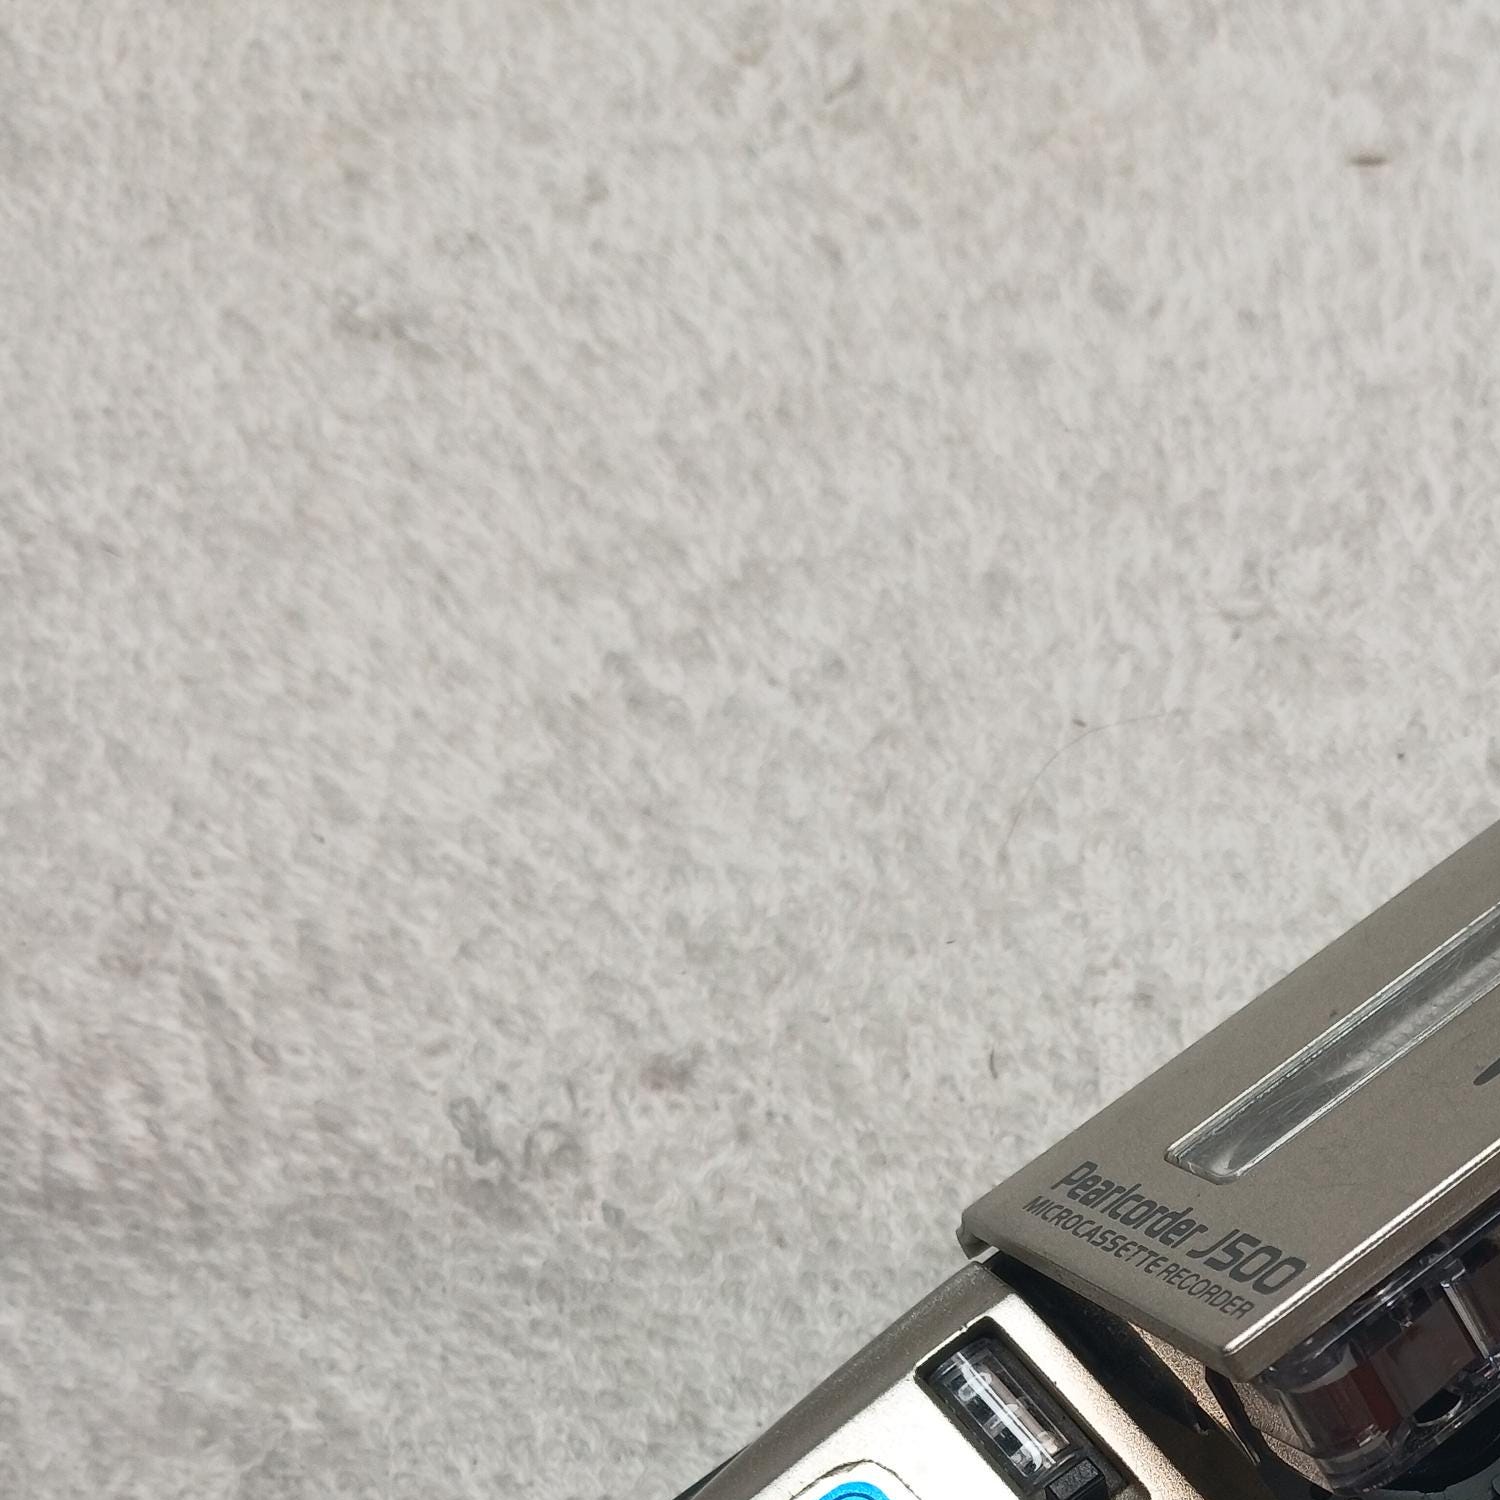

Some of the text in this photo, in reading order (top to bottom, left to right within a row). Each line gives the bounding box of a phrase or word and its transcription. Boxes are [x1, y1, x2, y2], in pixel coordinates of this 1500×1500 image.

[1022, 1195, 1256, 1321] MICROCASSETTE RECORDER
[1051, 1160, 1307, 1296] Pearlcorder J500
